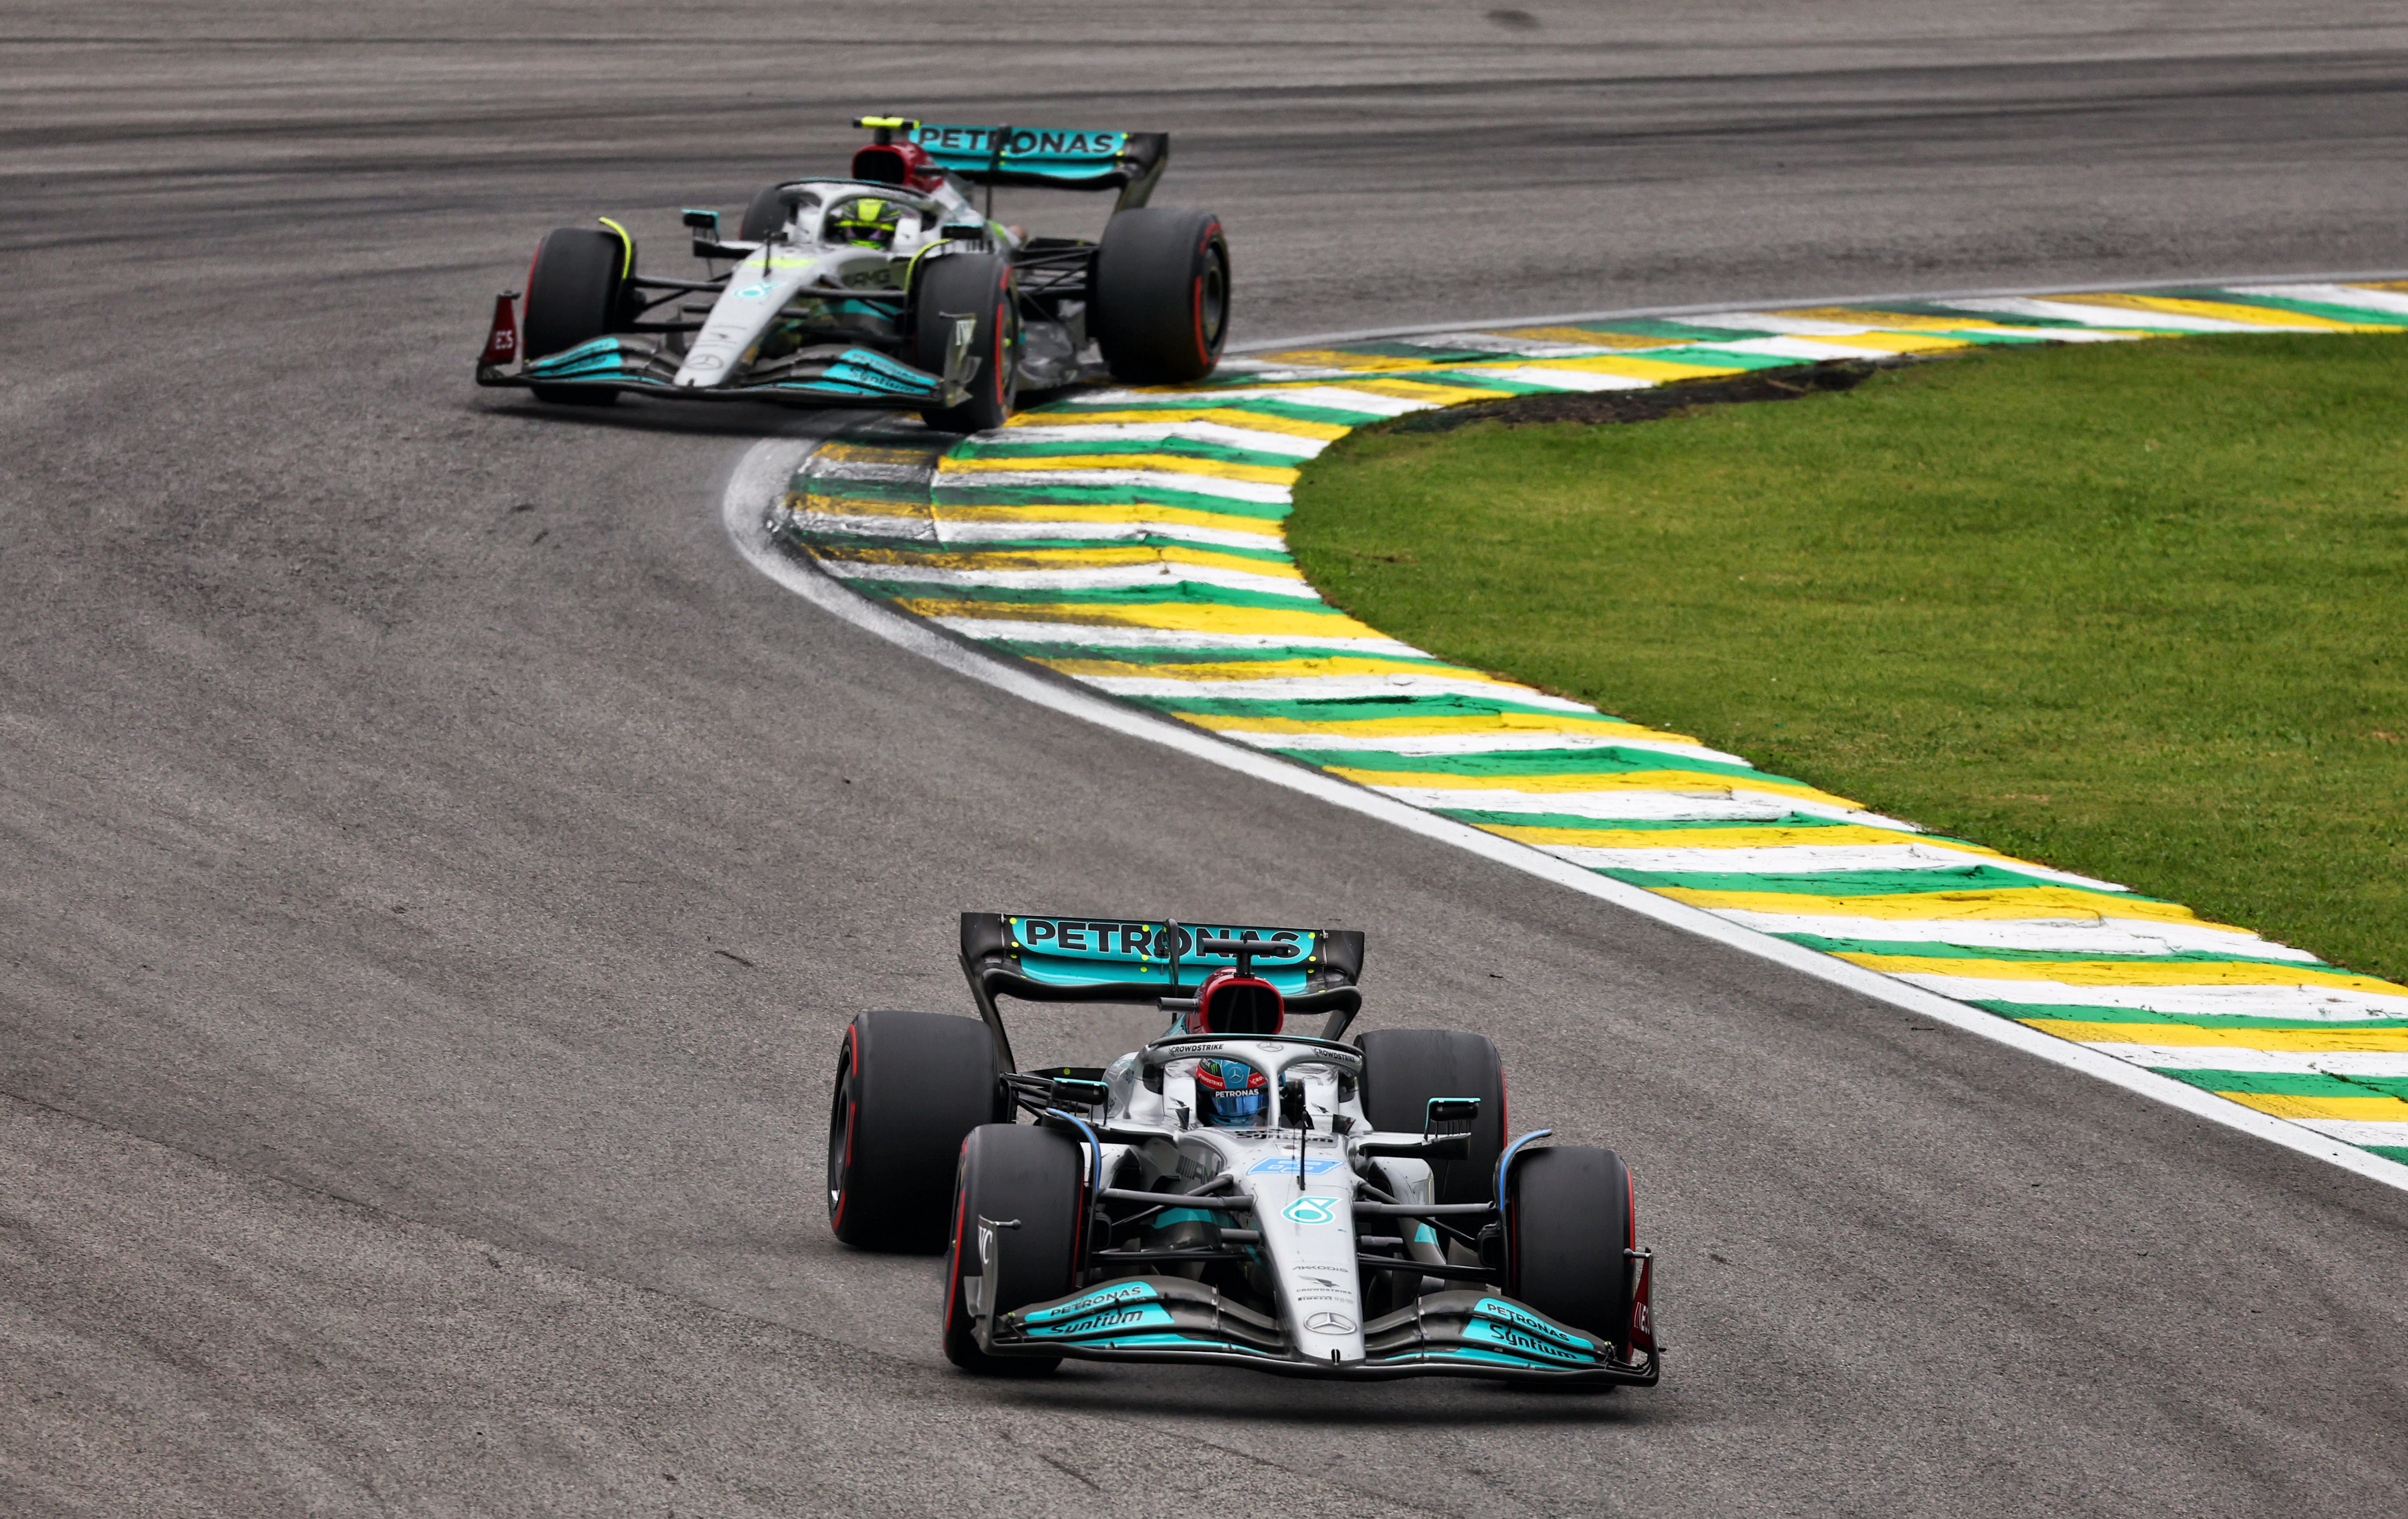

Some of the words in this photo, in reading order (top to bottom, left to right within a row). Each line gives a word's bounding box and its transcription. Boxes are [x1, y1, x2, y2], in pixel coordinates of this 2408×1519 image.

[1171, 1044, 1224, 1053] CROWDSTRIKE
[1314, 1048, 1355, 1063] CROWDSTRIKE
[1215, 1088, 1259, 1098] PETRONAS
[1050, 1286, 1141, 1316] PETRONAS
[1047, 1310, 1143, 1334] Syntium
[1487, 1303, 1570, 1341] PETRONAS
[1489, 1323, 1577, 1359] Syntium
